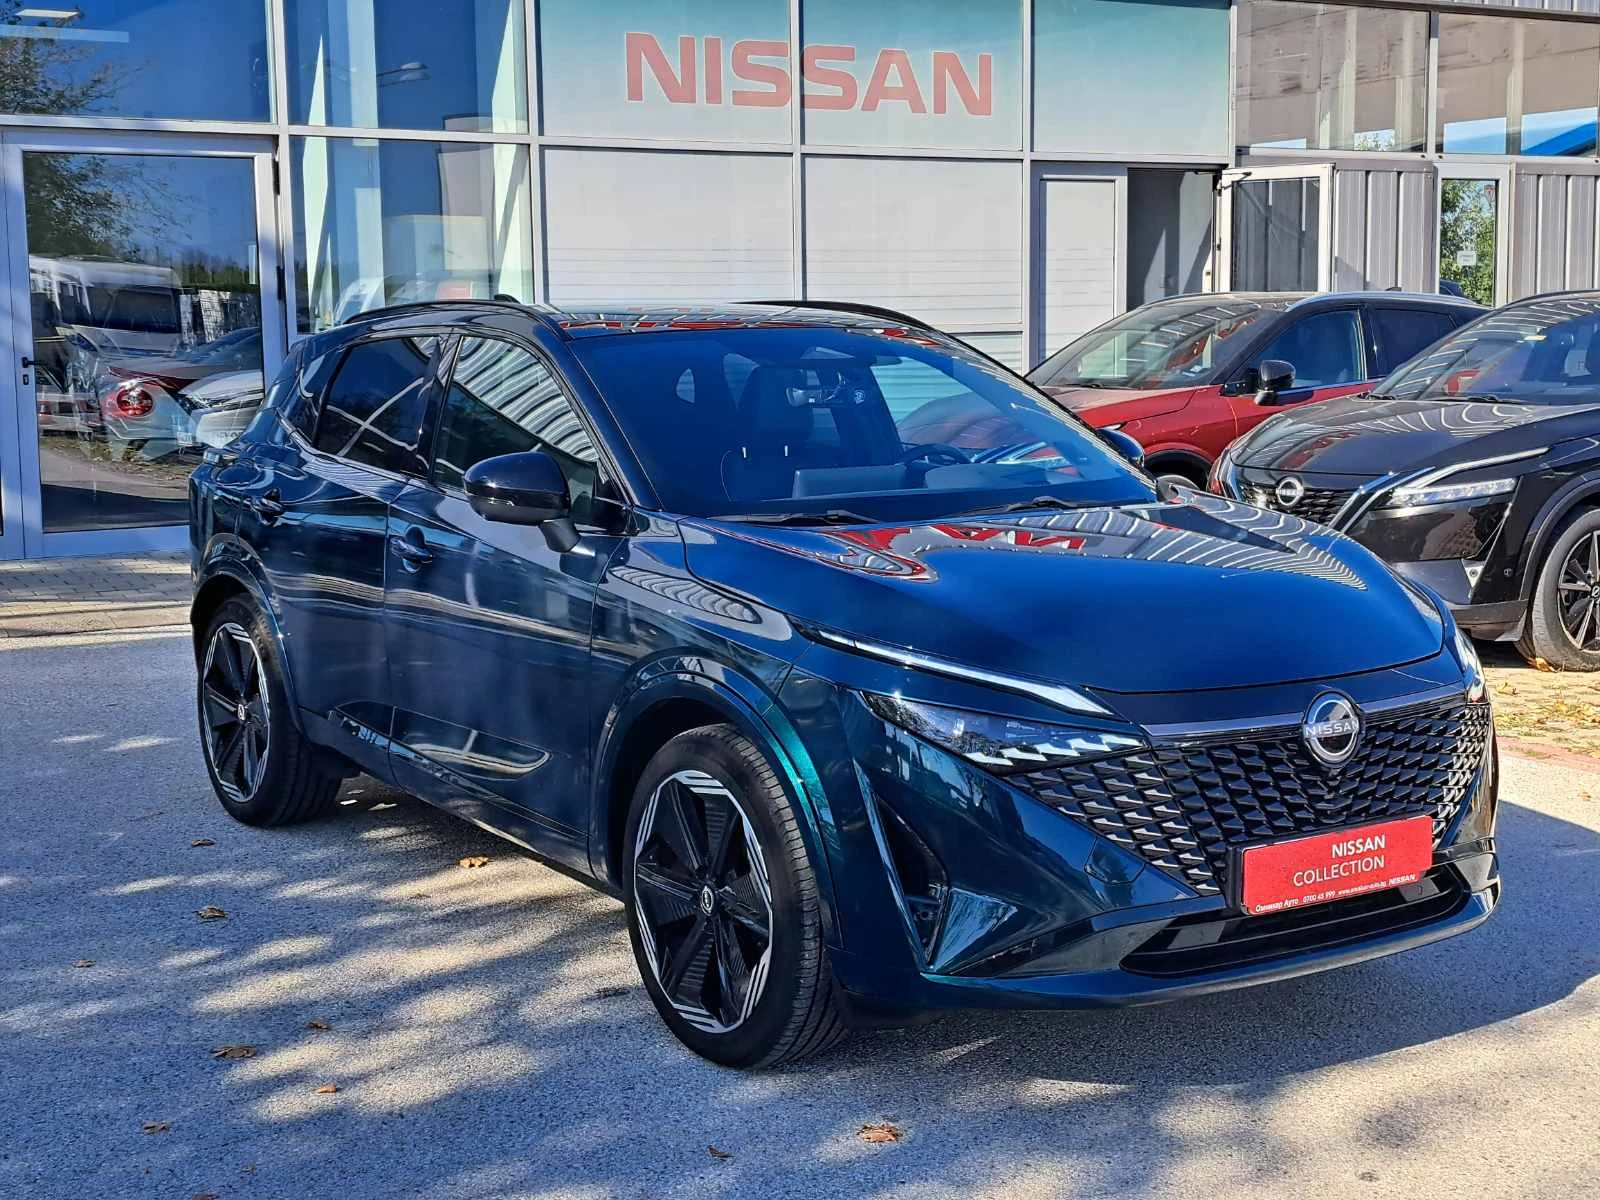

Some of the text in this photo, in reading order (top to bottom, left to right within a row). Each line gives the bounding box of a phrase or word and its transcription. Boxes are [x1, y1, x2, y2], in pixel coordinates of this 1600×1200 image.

[625, 32, 992, 117] NISSAN
[1305, 721, 1358, 735] NISSAN
[1331, 834, 1386, 859] NISSAN
[1293, 855, 1385, 887] COLLECTION
[1388, 874, 1416, 886] NISSAN
